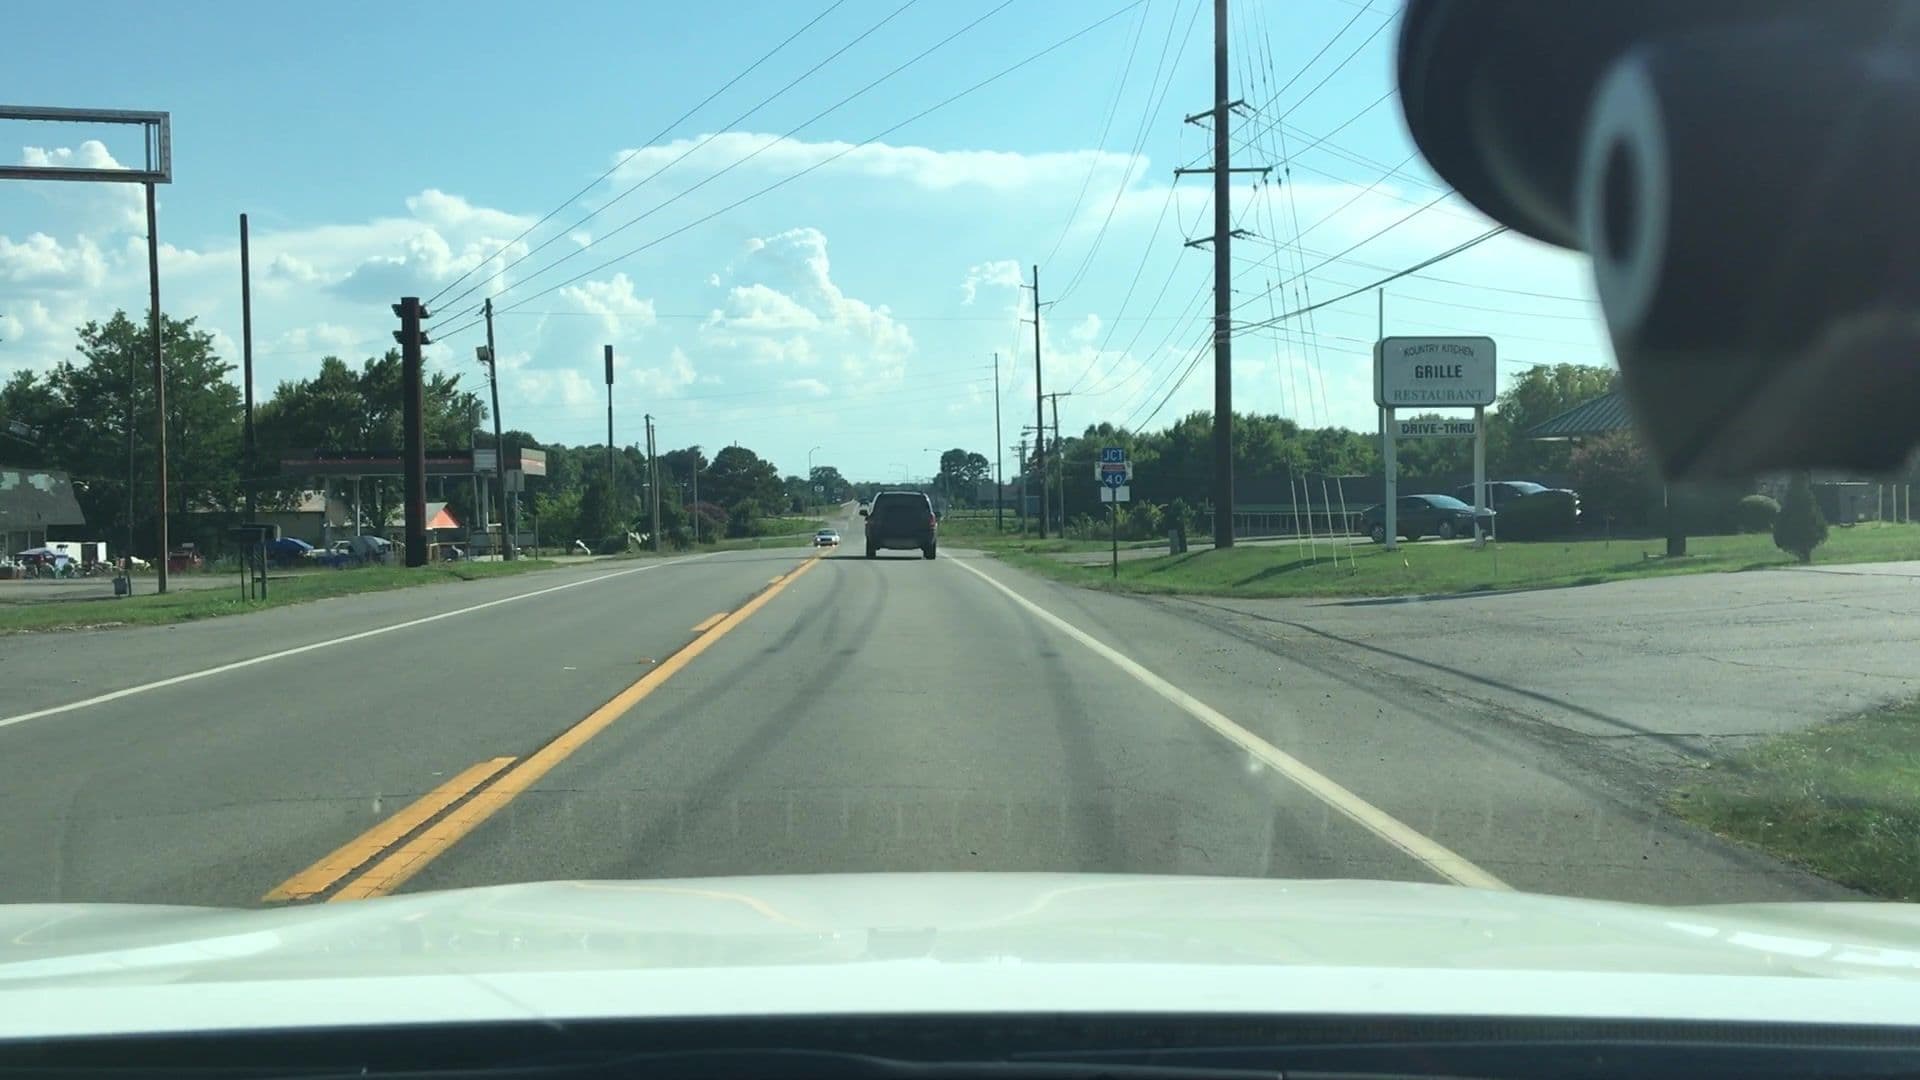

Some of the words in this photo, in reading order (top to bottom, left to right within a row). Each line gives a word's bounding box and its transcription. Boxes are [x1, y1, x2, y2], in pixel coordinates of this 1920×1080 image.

[1404, 344, 1439, 357] KOUNTRY
[1442, 344, 1474, 357] KITCHEN
[1415, 365, 1463, 379] GRILLE
[1393, 389, 1483, 401] RESTAURANT
[1401, 423, 1475, 434] DRIVE-THRU
